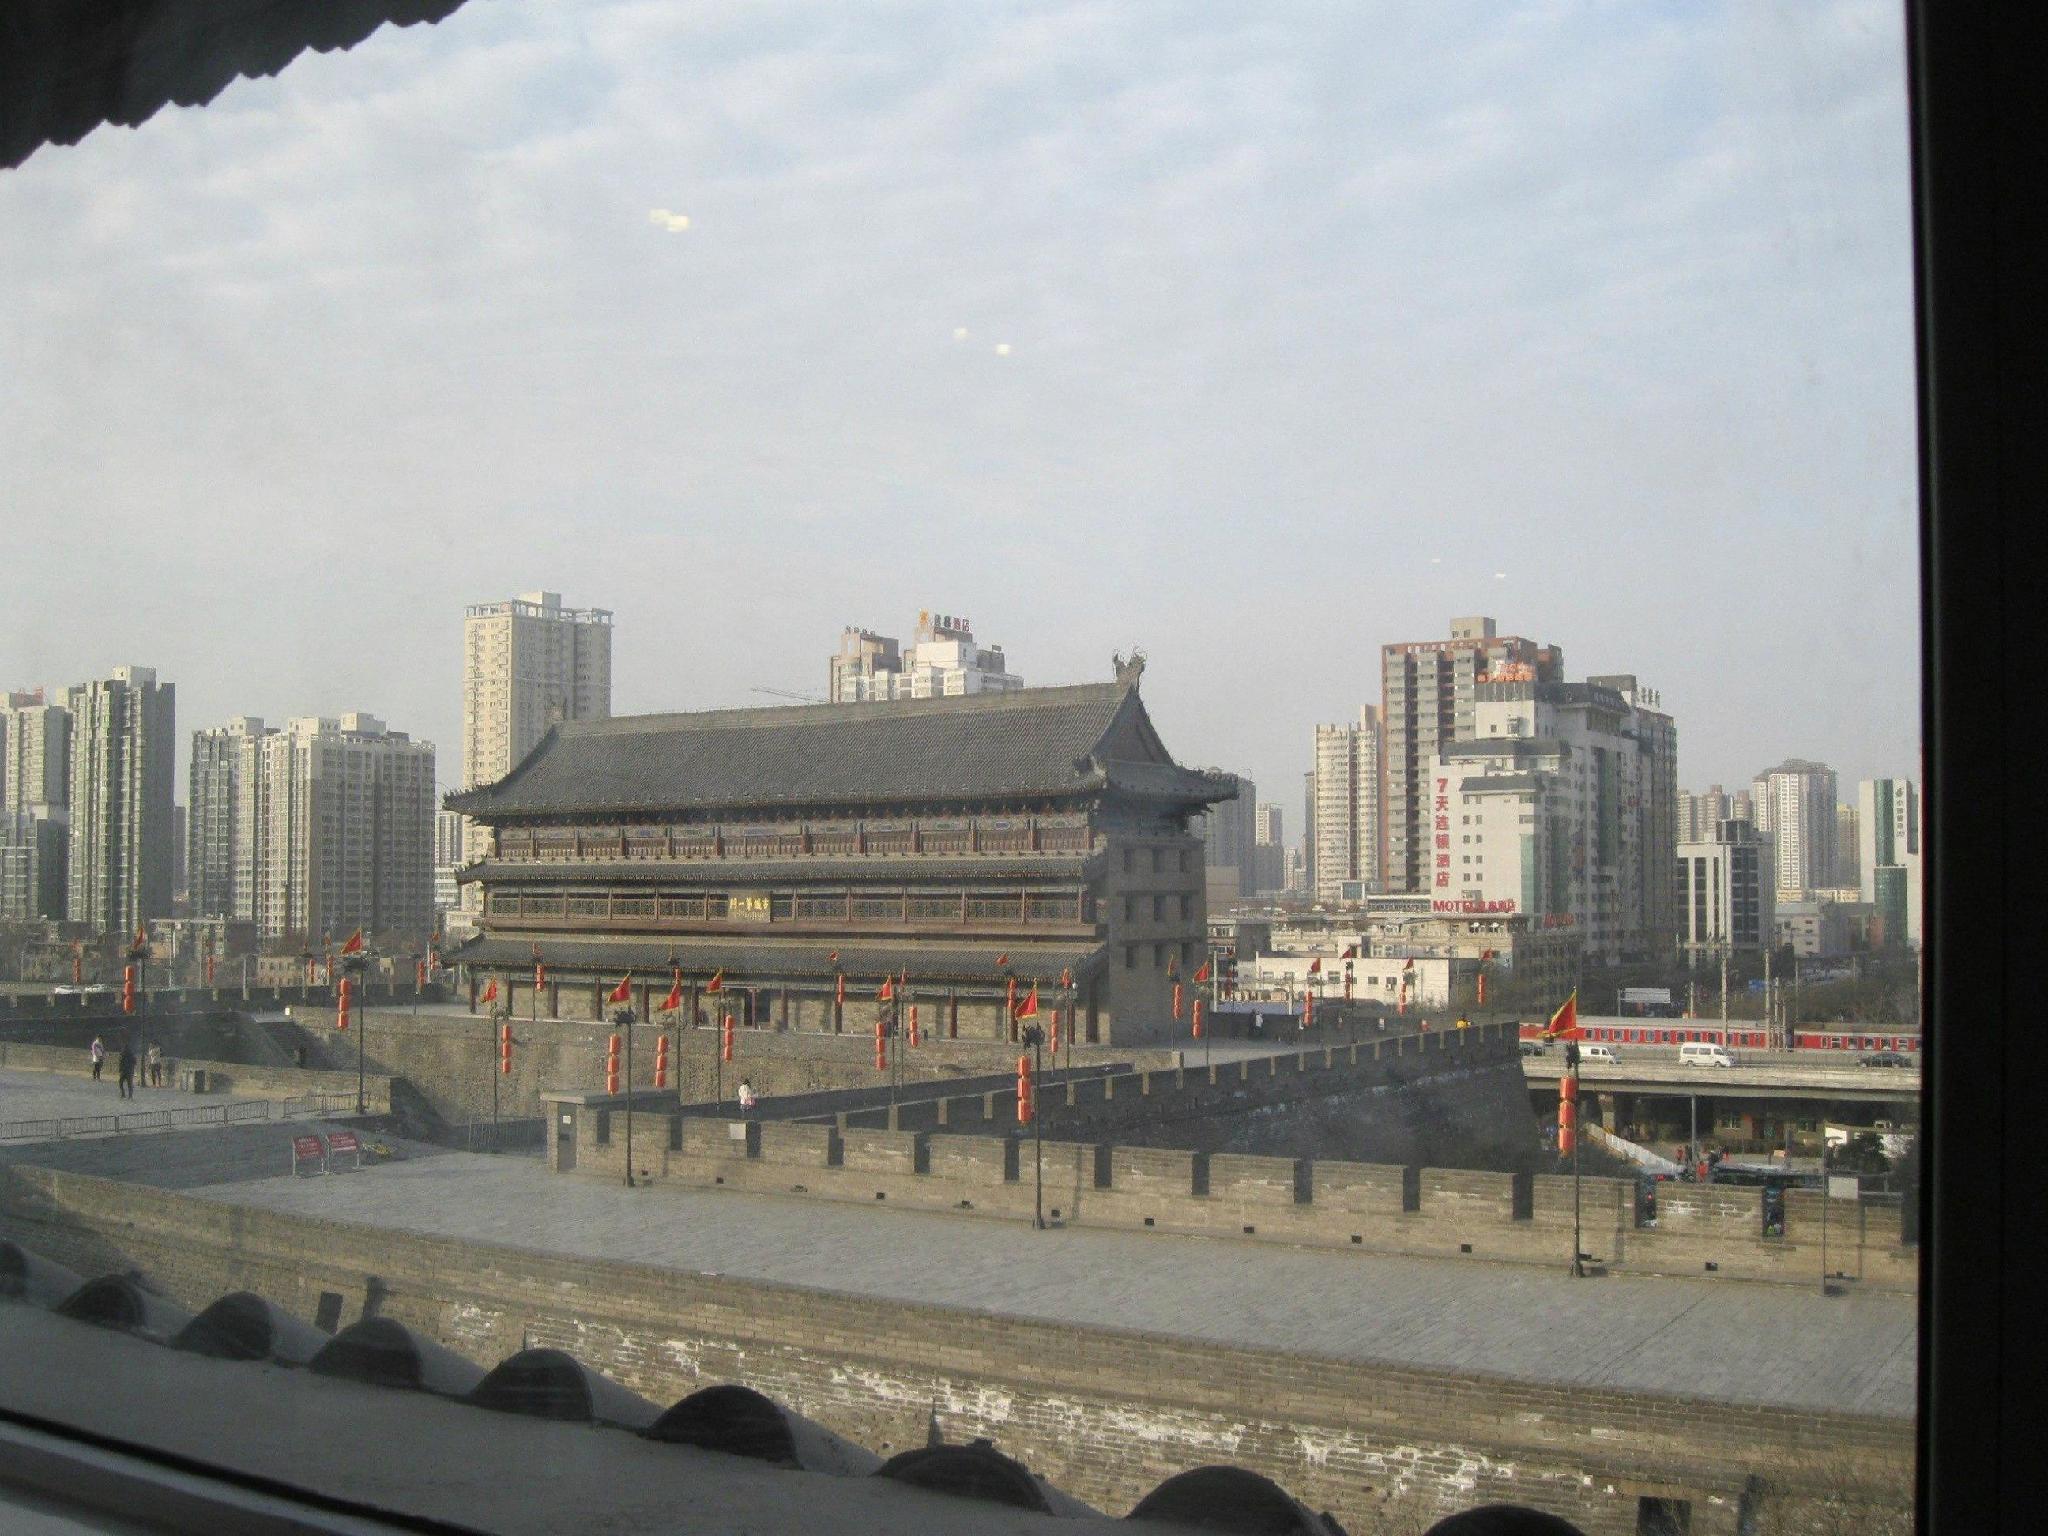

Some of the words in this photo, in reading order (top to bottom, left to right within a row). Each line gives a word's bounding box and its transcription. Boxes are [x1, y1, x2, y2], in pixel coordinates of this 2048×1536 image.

[1435, 778, 1450, 887] 7天连锁酒店
